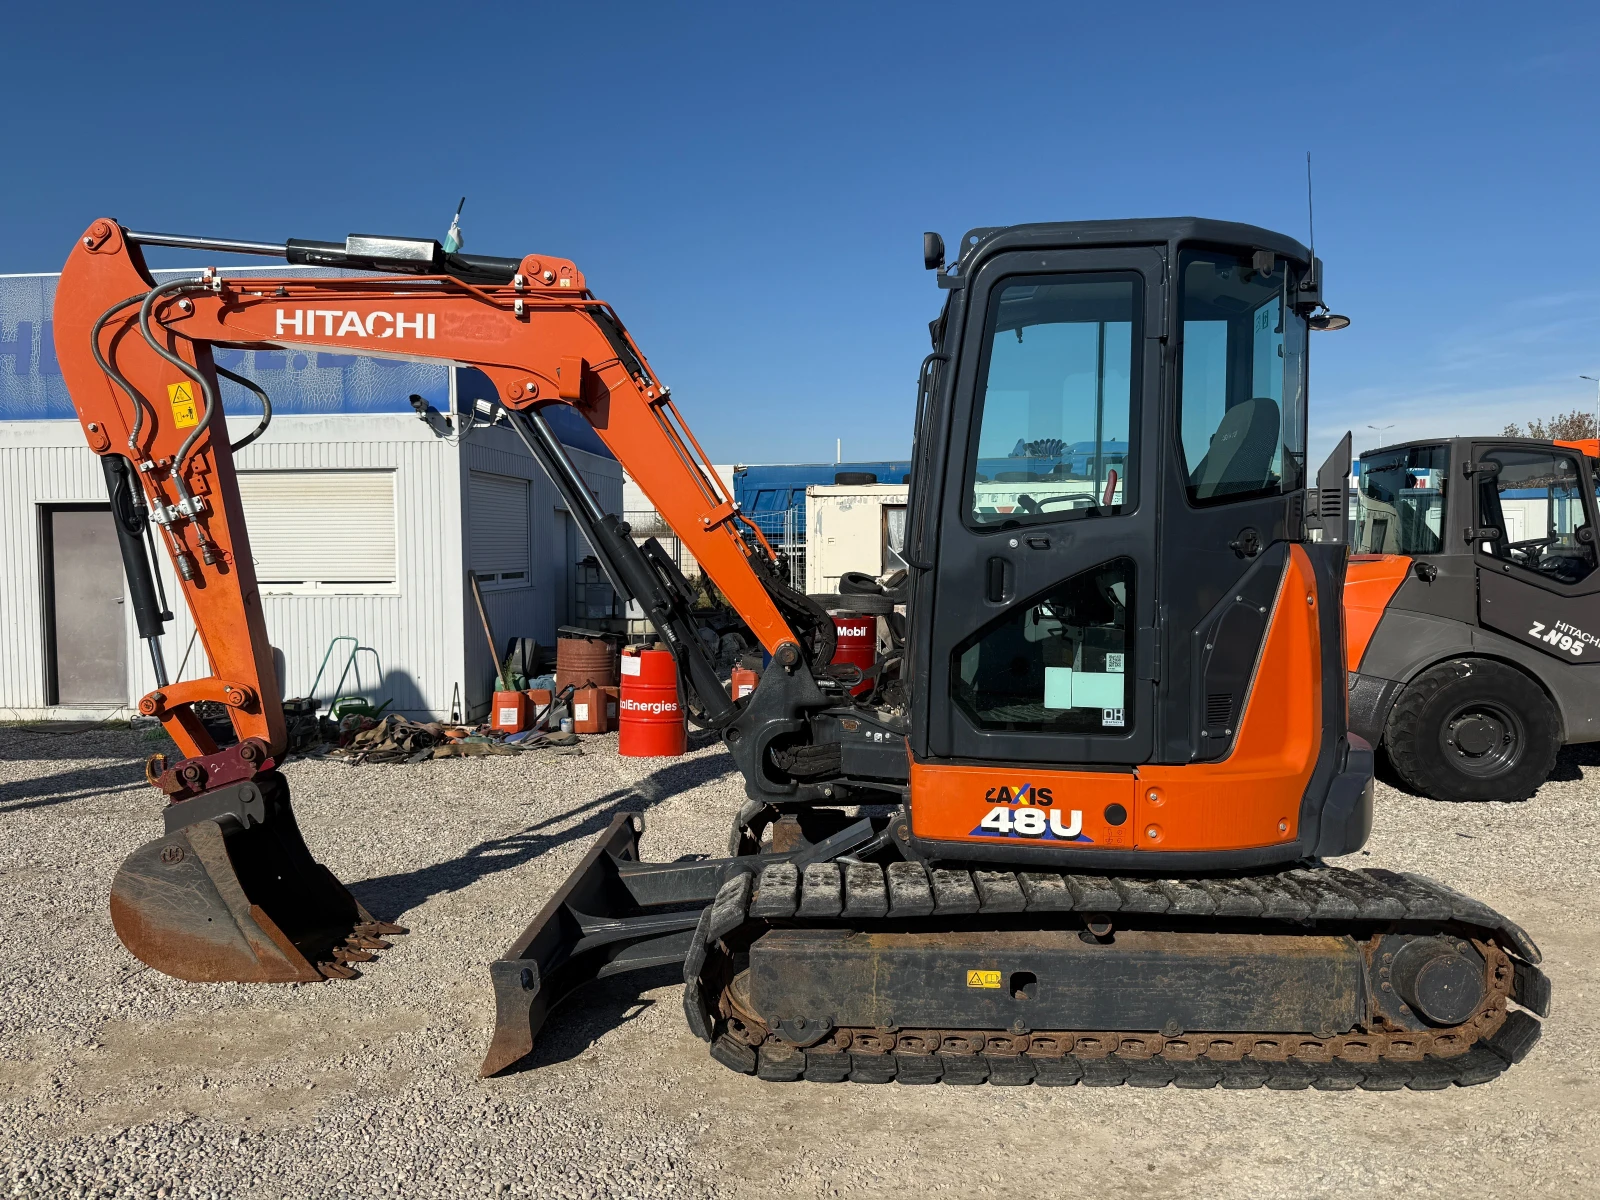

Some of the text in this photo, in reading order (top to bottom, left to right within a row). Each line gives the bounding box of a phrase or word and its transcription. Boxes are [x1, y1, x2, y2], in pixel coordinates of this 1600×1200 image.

[275, 308, 436, 340] HITACHI
[837, 626, 866, 637] Mobil
[980, 806, 1083, 840] 48U
